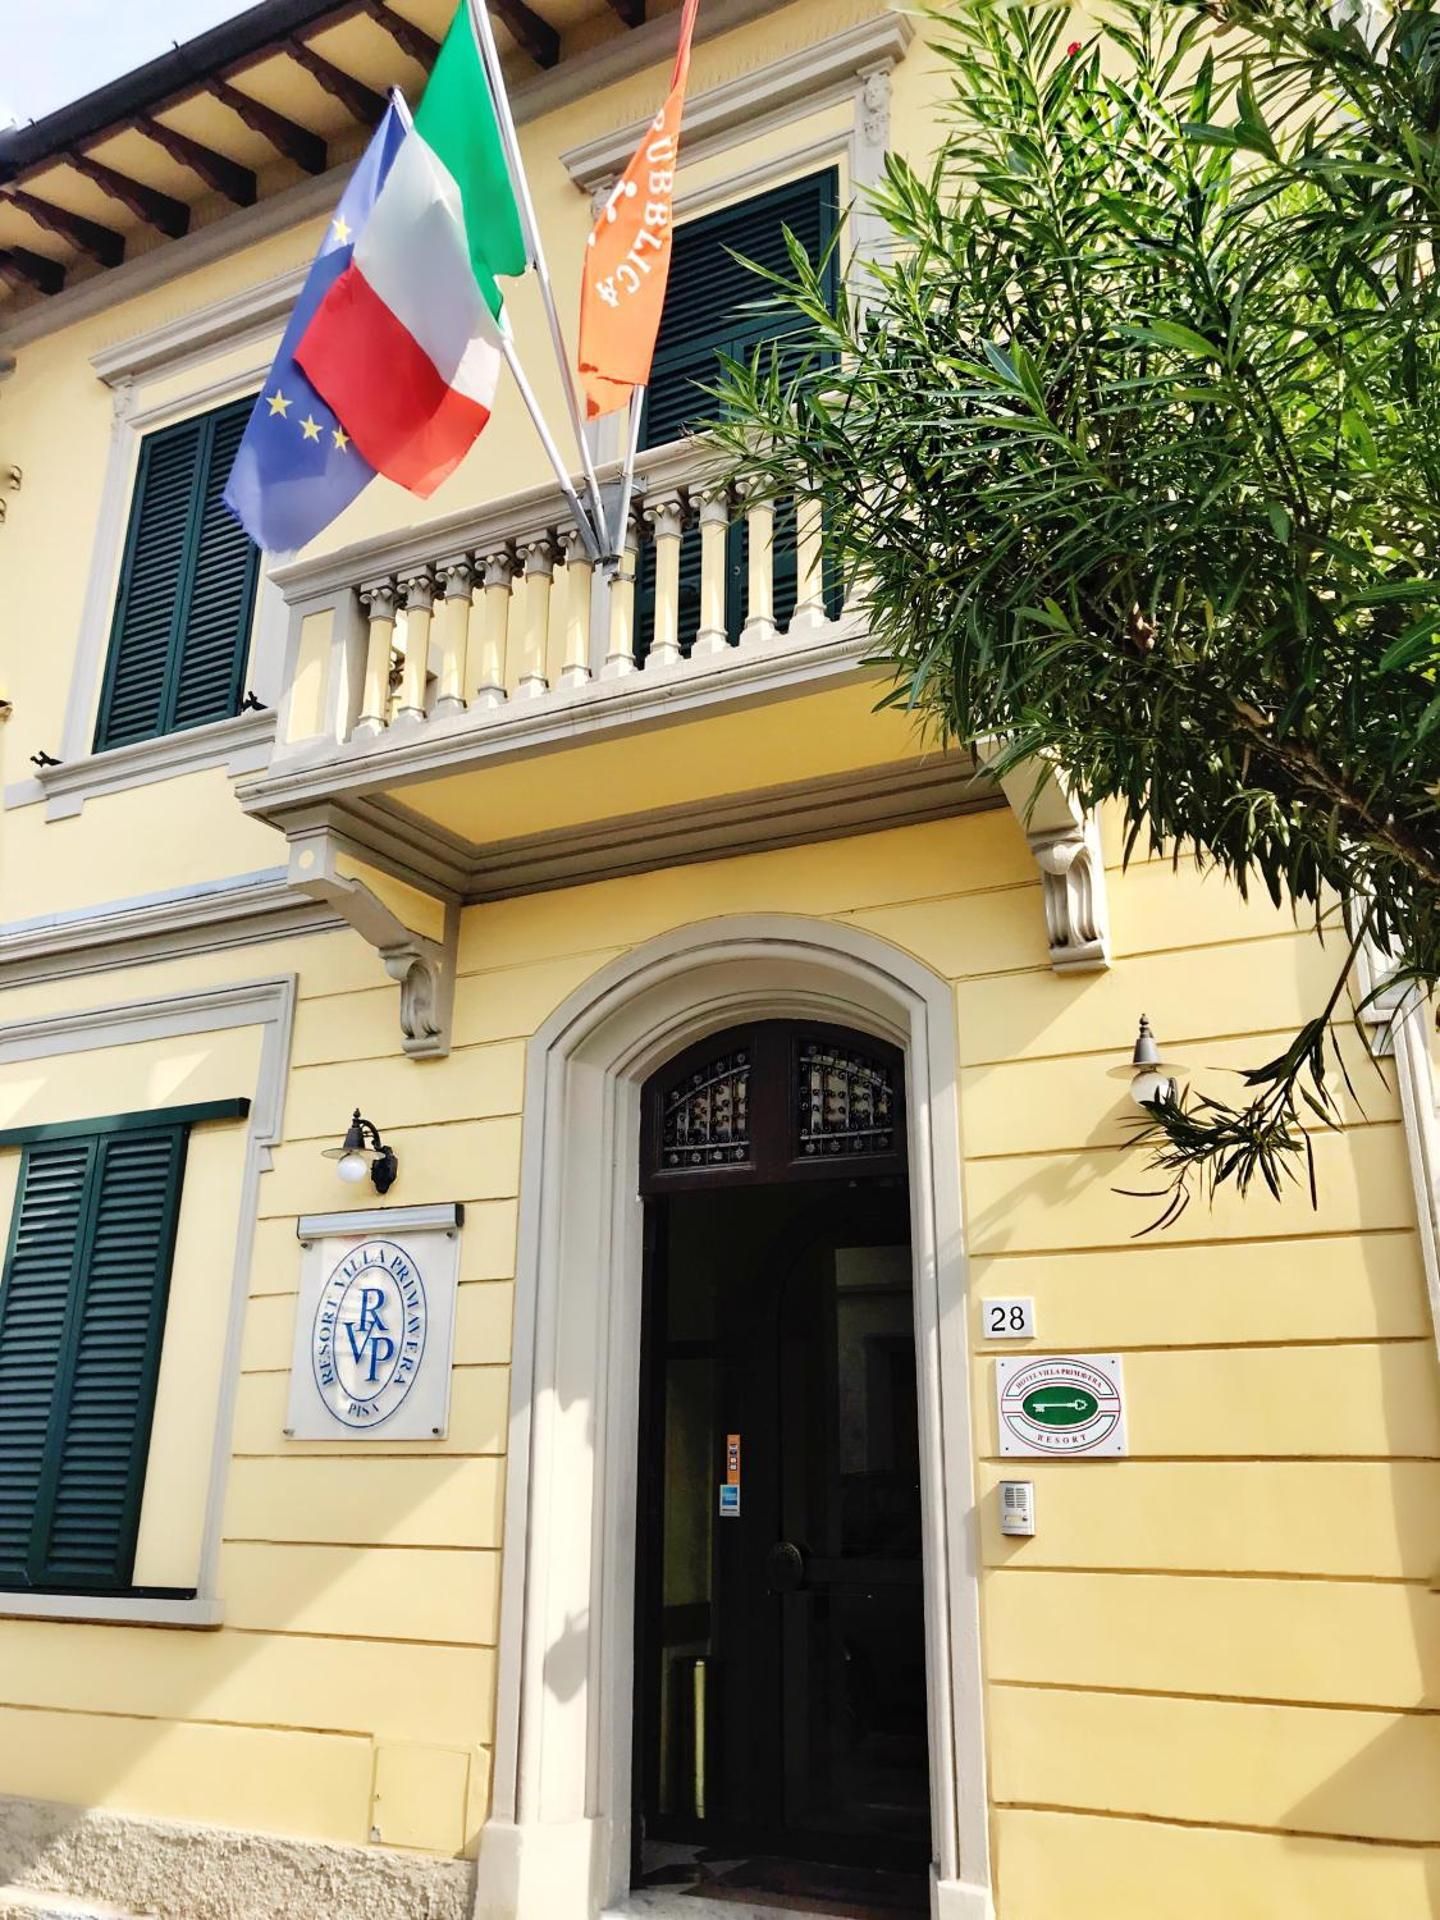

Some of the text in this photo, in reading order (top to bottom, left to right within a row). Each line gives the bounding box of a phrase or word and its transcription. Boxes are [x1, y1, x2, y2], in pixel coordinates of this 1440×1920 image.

[319, 1249, 420, 1386] RESORT VILLA PRIMAVERA
[991, 1306, 1026, 1332] 28
[1038, 1368, 1061, 1377] VILLA
[348, 1402, 380, 1418] PISA
[1037, 1433, 1087, 1444] RESORT
